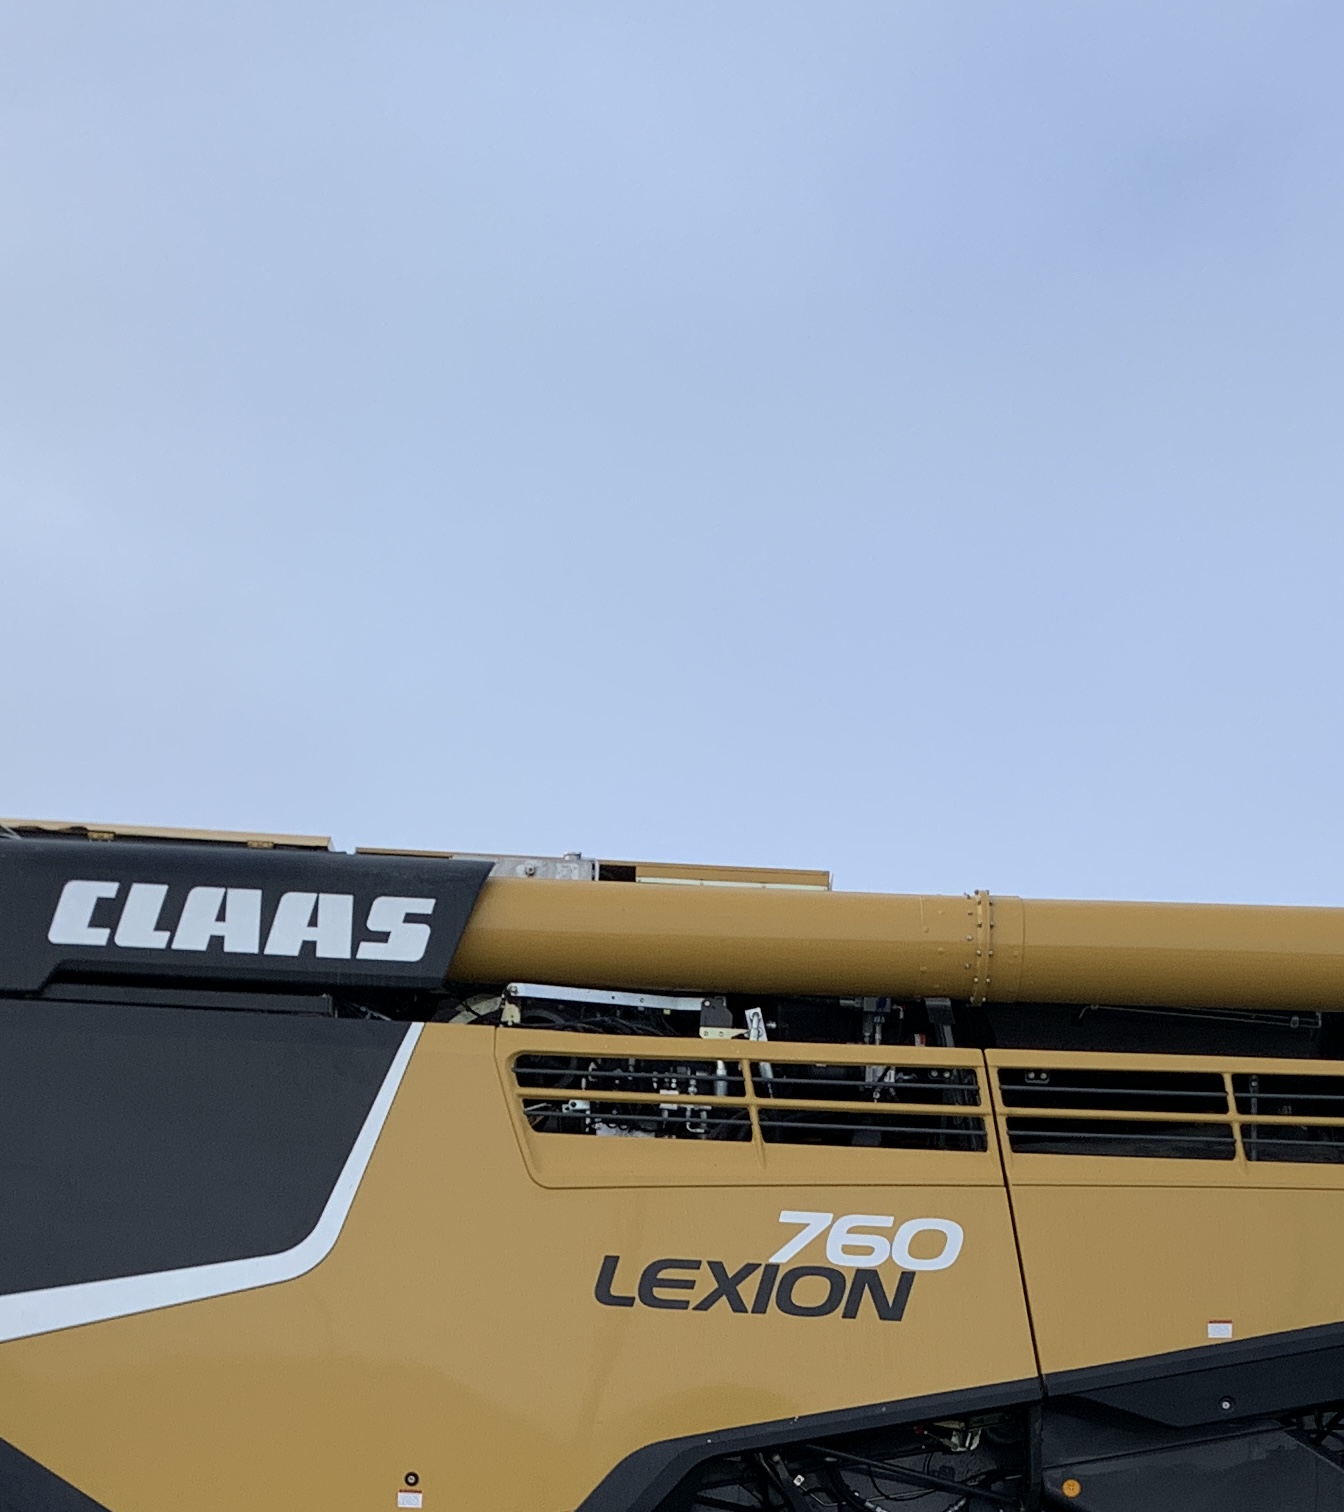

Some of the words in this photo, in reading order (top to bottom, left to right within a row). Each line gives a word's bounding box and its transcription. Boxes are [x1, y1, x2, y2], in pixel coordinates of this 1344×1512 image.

[47, 879, 437, 962] CLAAS
[768, 1210, 965, 1271] 760
[594, 1255, 916, 1322] LEXION
